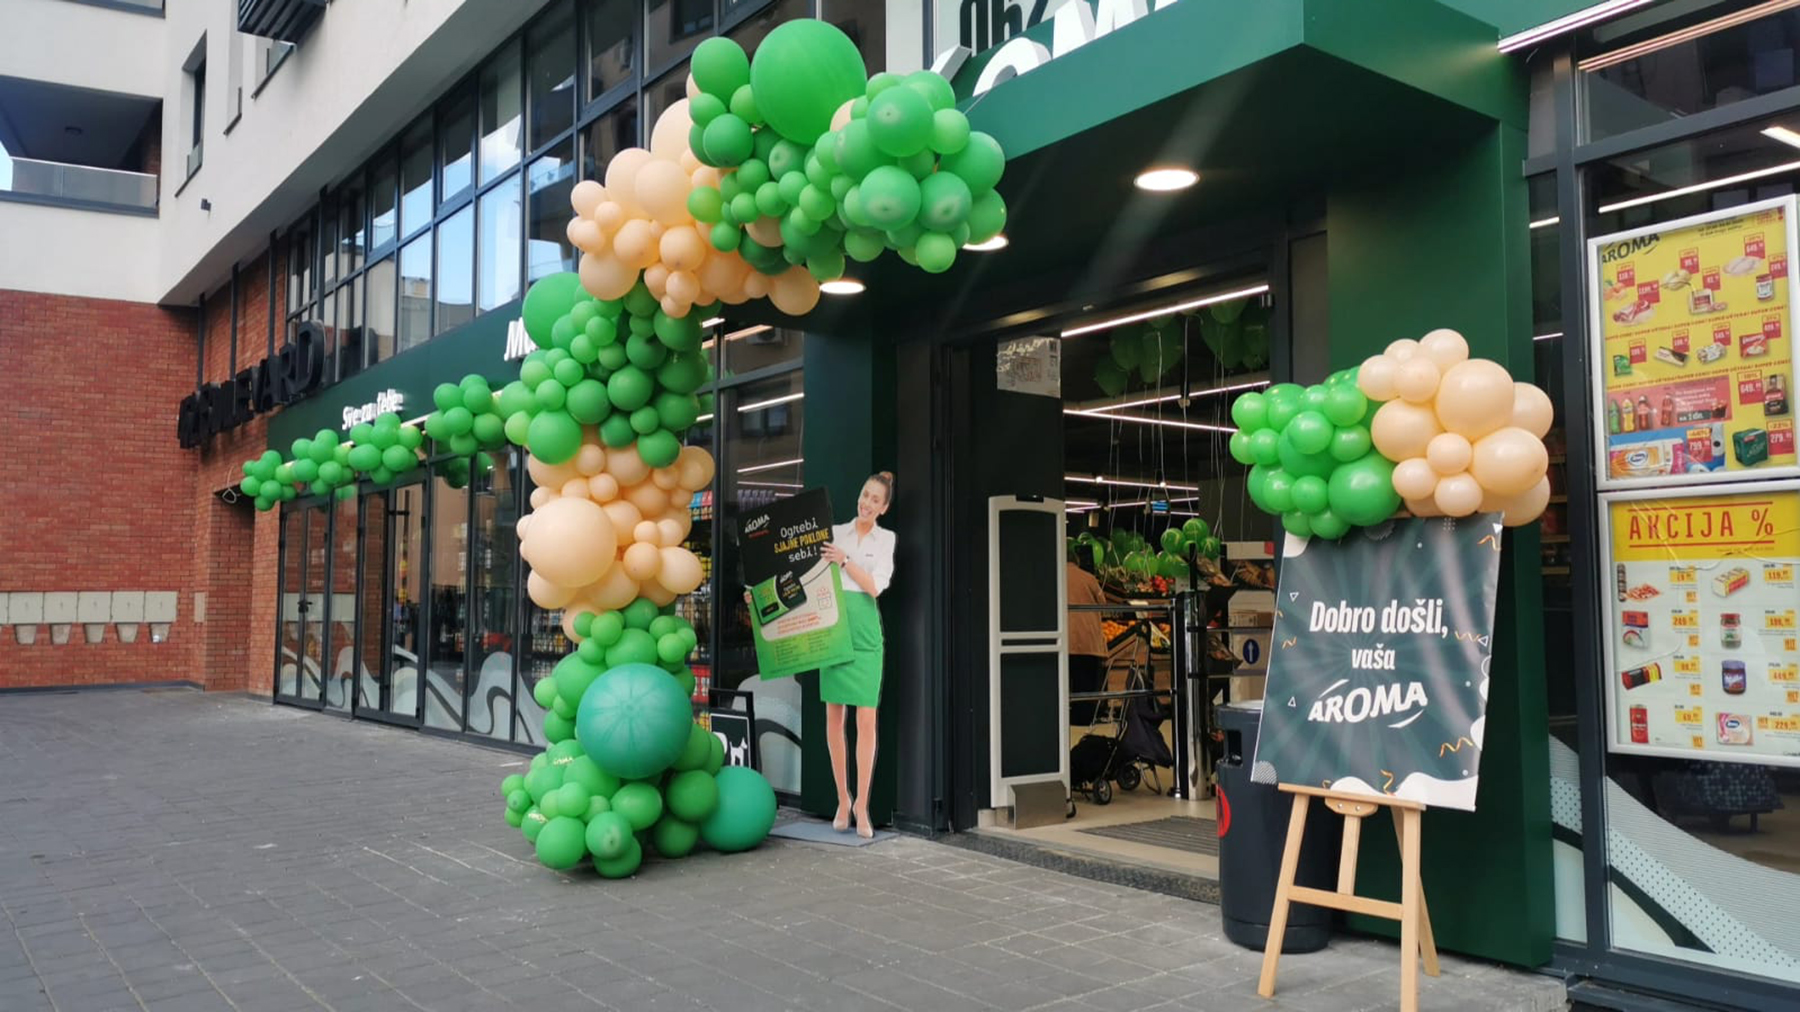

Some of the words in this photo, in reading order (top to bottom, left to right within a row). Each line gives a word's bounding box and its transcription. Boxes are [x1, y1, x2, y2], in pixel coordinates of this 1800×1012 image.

[780, 517, 819, 539] Ogrebi
[1629, 511, 1734, 541] AKCIJA
[1751, 508, 1774, 537] %
[774, 537, 799, 553] SJAJNE
[799, 528, 829, 546] POKLONE
[1309, 600, 1376, 633] Dobro
[1380, 598, 1448, 639] došli,
[1351, 643, 1396, 670] vaša
[1308, 681, 1428, 723] AROMA
